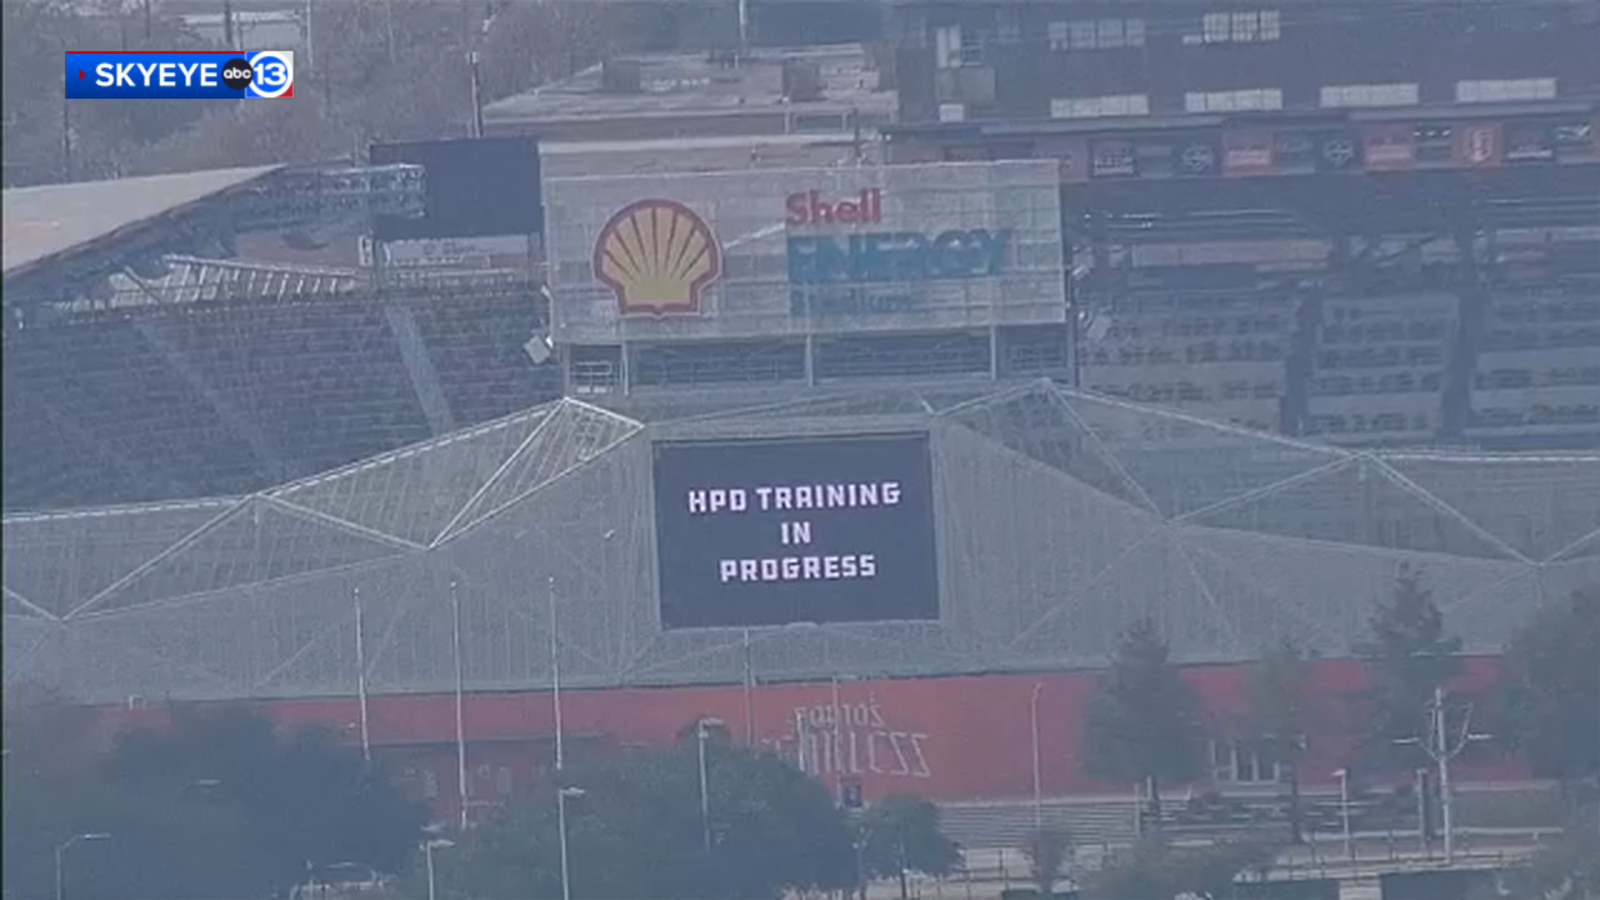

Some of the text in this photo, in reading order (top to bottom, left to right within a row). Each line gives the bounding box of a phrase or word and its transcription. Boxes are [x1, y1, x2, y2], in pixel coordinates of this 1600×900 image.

[785, 188, 882, 225] Shell
[688, 482, 902, 513] HPD TRAINING
[780, 521, 812, 545] IN
[719, 554, 877, 582] PROGRESS
